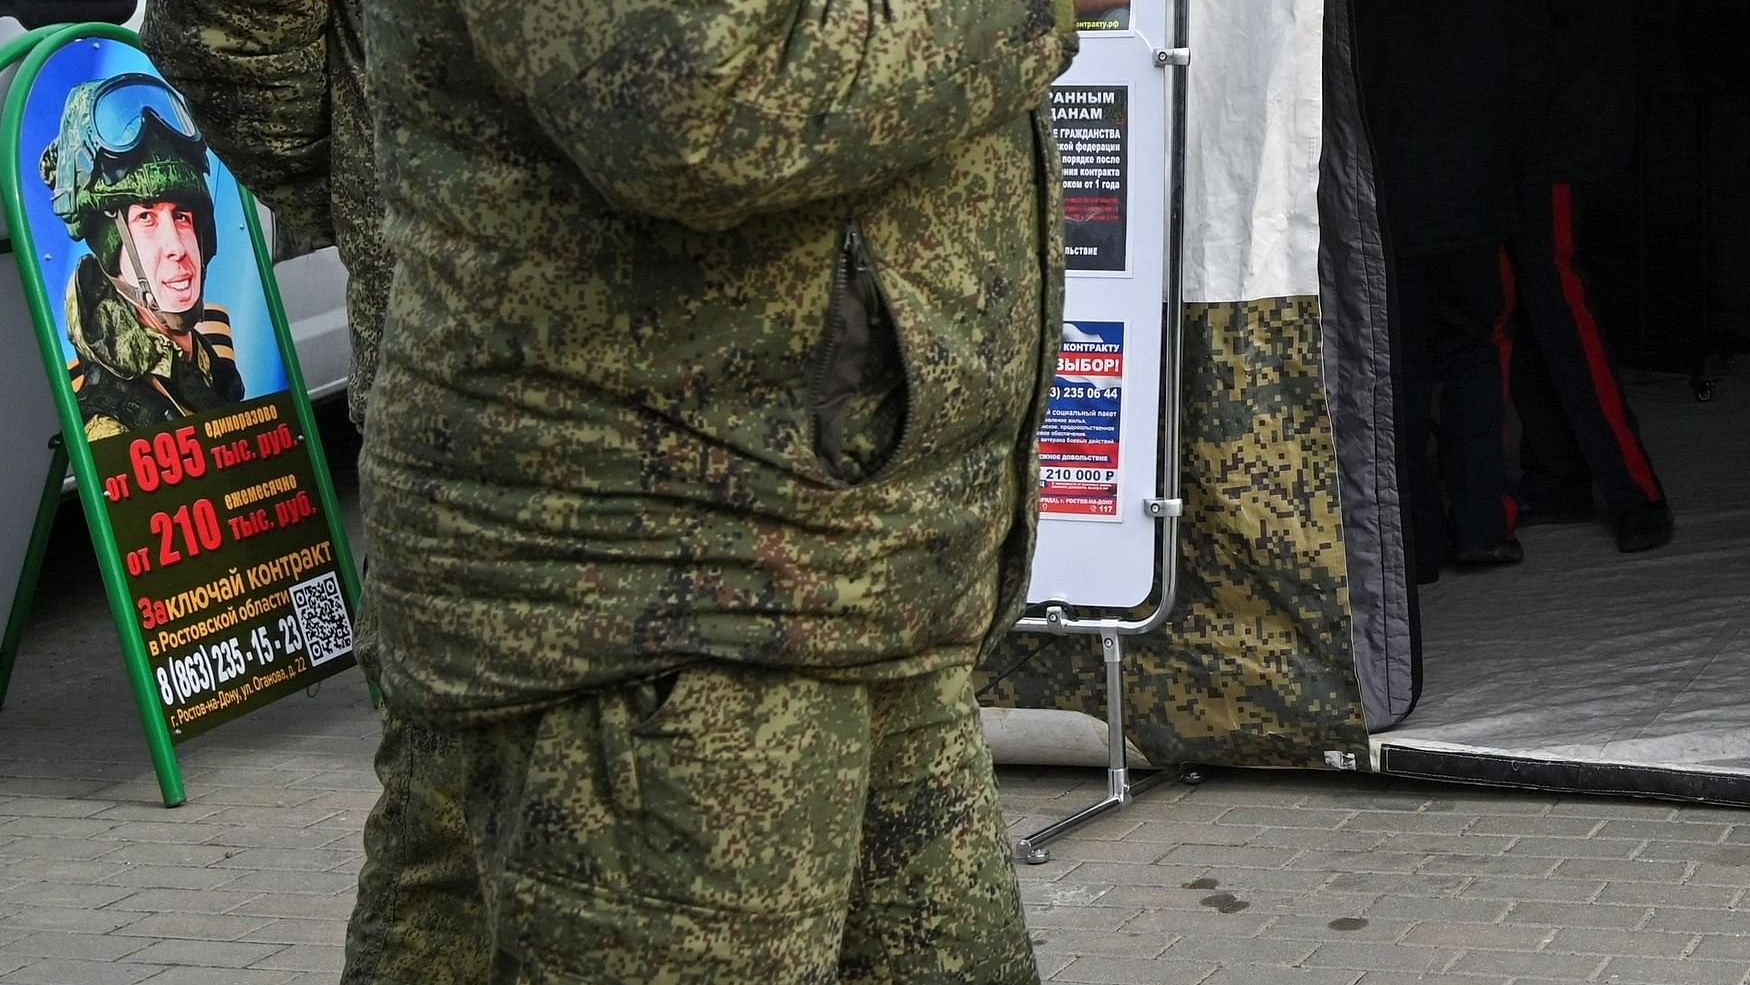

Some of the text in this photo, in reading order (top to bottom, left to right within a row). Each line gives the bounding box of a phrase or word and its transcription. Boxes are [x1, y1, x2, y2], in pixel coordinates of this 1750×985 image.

[1076, 20, 1120, 29] онтракту.рф
[1060, 128, 1120, 140] ГРАЖДАНСТВА
[1076, 141, 1120, 153] федерации
[1062, 156, 1120, 165] порядке после
[1062, 168, 1120, 178] ния контракта
[1095, 179, 1099, 188] 1
[1102, 181, 1120, 191] года
[1063, 343, 1120, 352] КОНТРАКТУ
[1049, 387, 1117, 400] 3) 235 06 44
[204, 404, 278, 438] единоразово
[105, 423, 297, 501] от 695 тыс. руб.
[1046, 469, 1071, 479] 210
[1076, 470, 1100, 480] 000
[224, 473, 297, 510] ежемесячно
[127, 491, 317, 576] от 210 тыс. руб.
[138, 541, 332, 630] Заключай контракт
[149, 590, 290, 656] в Ростовской области
[157, 666, 174, 705] 8
[169, 645, 216, 704] (863)
[211, 637, 246, 682] 235
[251, 626, 274, 665] 15
[278, 615, 303, 654] 23
[177, 686, 242, 725] Ростов-на-Дону,
[242, 683, 253, 701] ул.
[295, 657, 307, 673] 22
